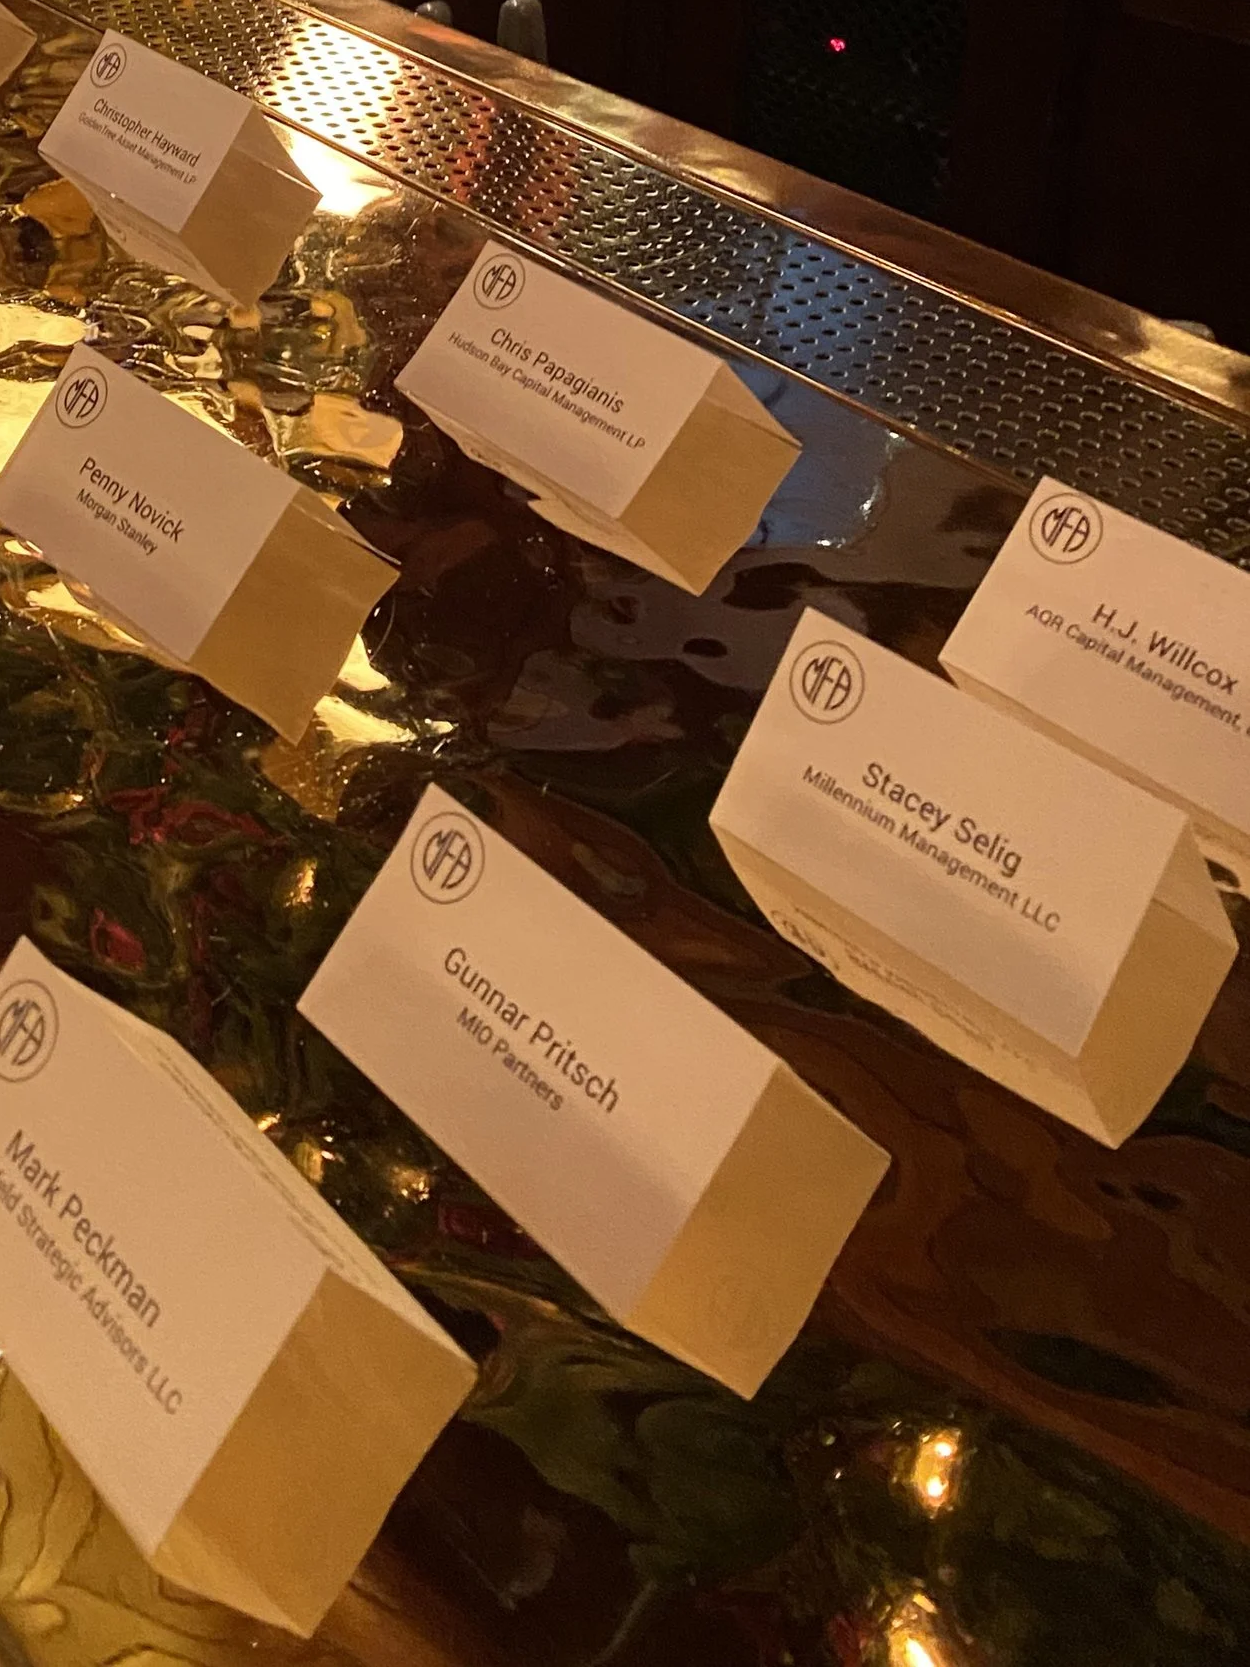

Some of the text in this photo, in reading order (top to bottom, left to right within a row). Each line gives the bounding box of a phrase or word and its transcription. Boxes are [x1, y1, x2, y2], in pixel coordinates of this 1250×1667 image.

[92, 97, 202, 169] Christopher Hayward
[114, 133, 139, 155] Asset
[135, 144, 186, 182] Management
[446, 330, 647, 450] Hudson Bay Capital Management LP
[489, 327, 625, 414] Chris Papagianis
[75, 487, 159, 557] Morgan Stanley
[78, 455, 185, 544] Penny Novick
[1024, 603, 1066, 634] AQR
[1064, 622, 1127, 666] Capital
[1147, 629, 1240, 697] Willcox
[801, 764, 1062, 934] Millennium Management LLC
[861, 761, 1023, 880] Stacey Selig
[443, 946, 620, 1114] Gunnar Pritsch
[455, 1005, 565, 1112] MIO Partners
[4, 1128, 162, 1330] Mark Peckman
[15, 1202, 85, 1294] Strategic
[78, 1284, 150, 1377] Advisors
[144, 1365, 184, 1417] LLC
